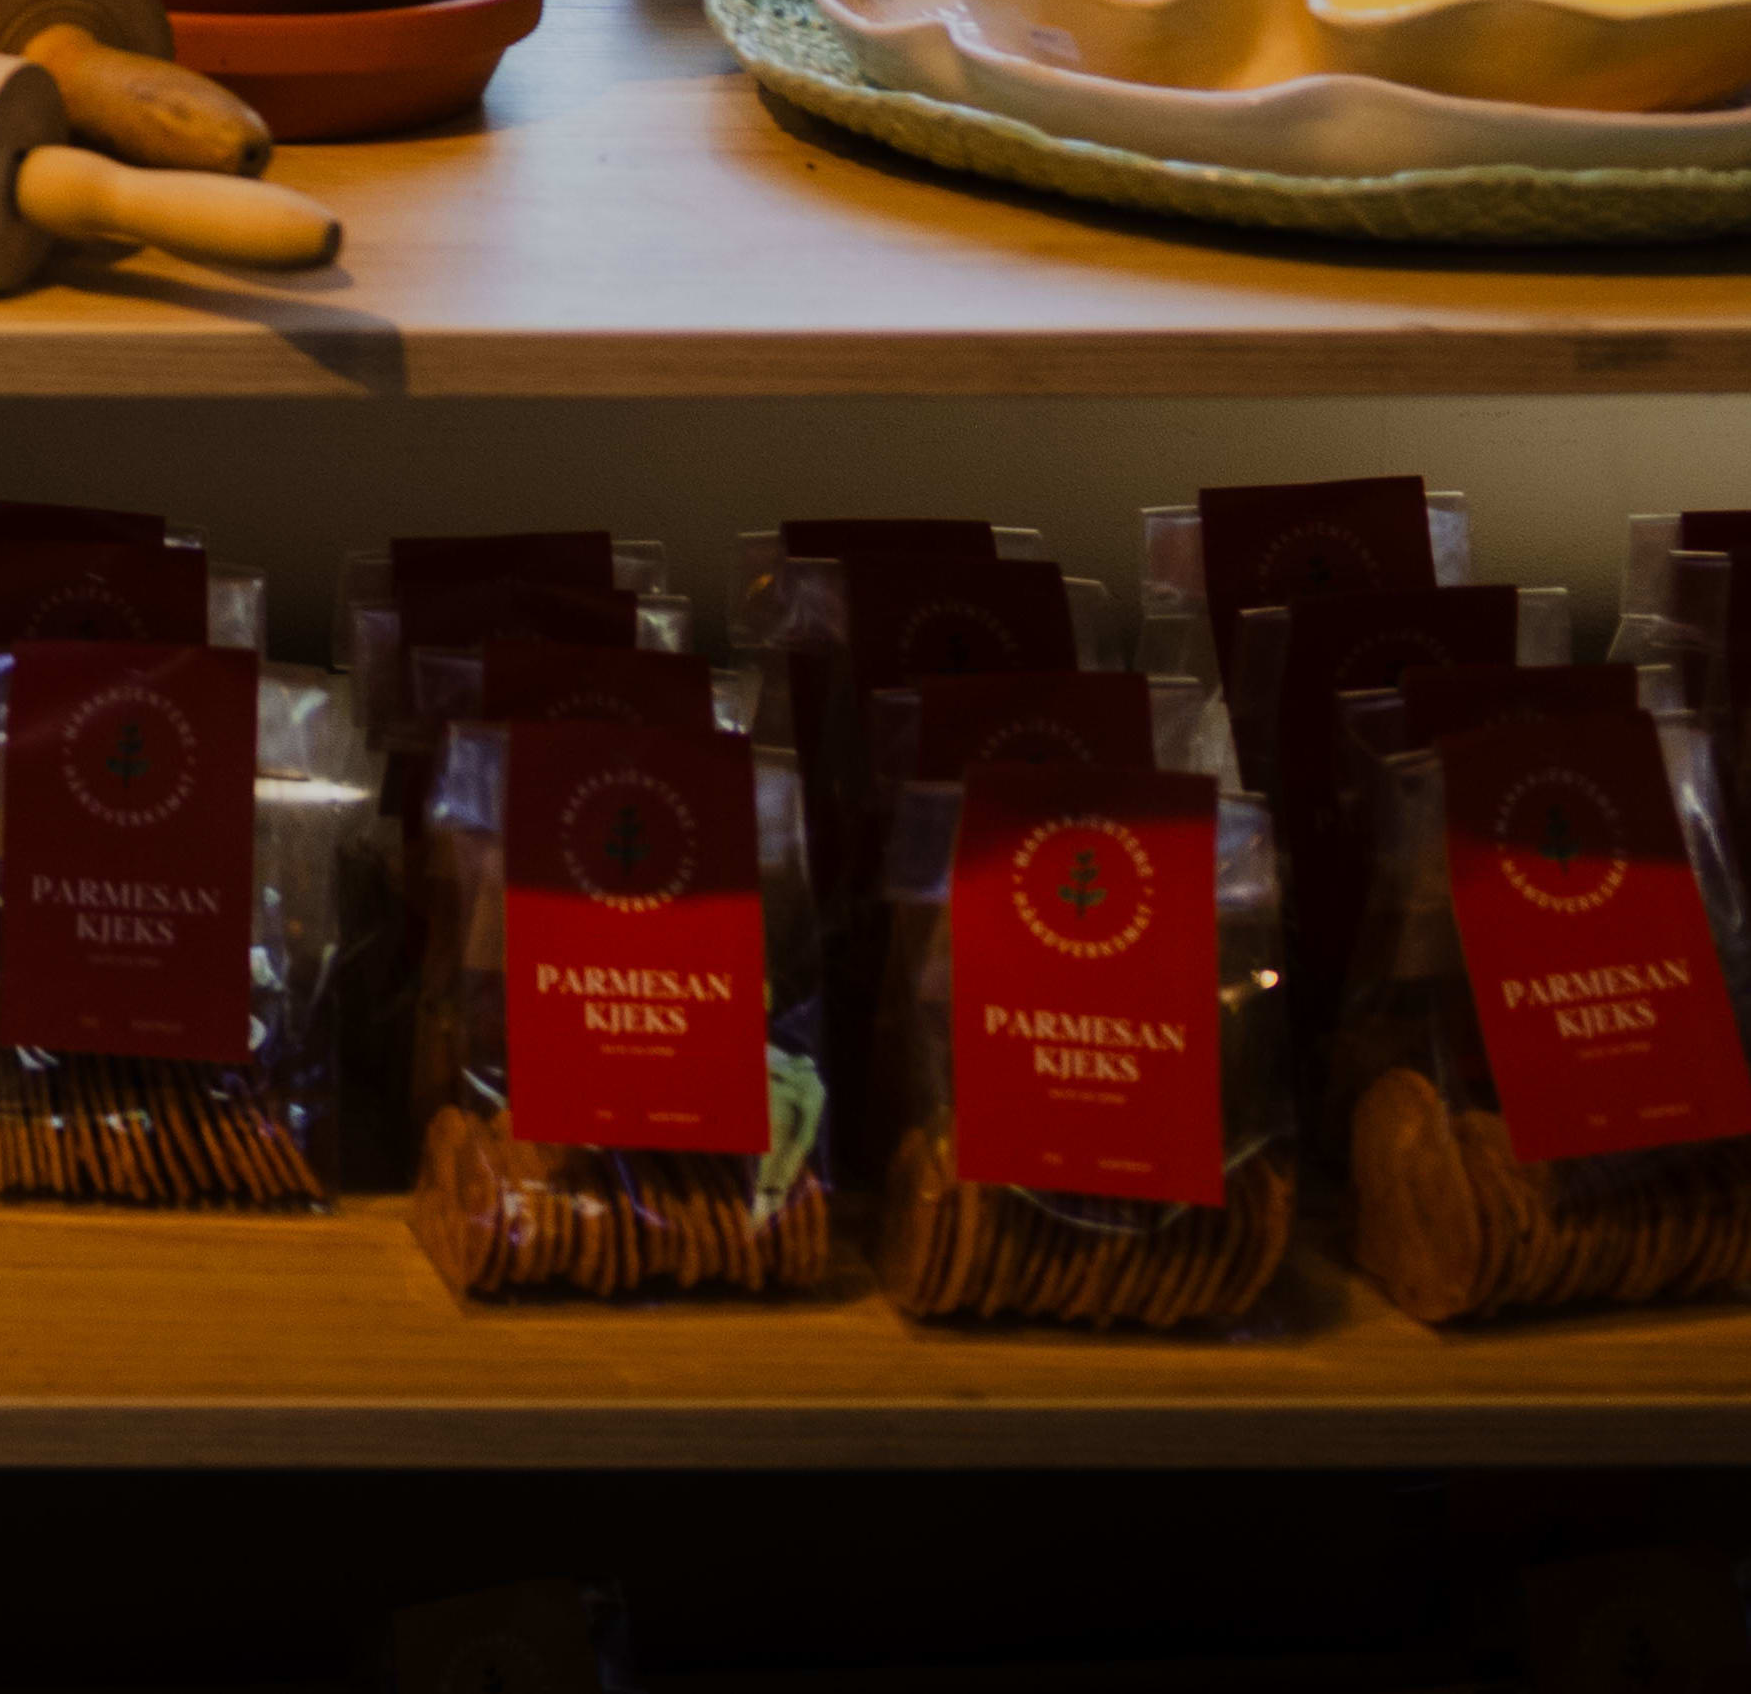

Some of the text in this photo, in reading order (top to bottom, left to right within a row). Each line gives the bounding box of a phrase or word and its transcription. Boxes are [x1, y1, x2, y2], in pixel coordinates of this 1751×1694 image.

[29, 872, 222, 916] PARMESAN
[73, 911, 177, 947] KJEKS
[534, 962, 733, 1003] PARMESAN
[1500, 956, 1693, 1011] PARMESAN
[582, 998, 690, 1037] KJEKS
[983, 1003, 1188, 1055] PARMESAN
[1554, 997, 1660, 1041] KJEKS
[1032, 1043, 1141, 1083] KJEKS
